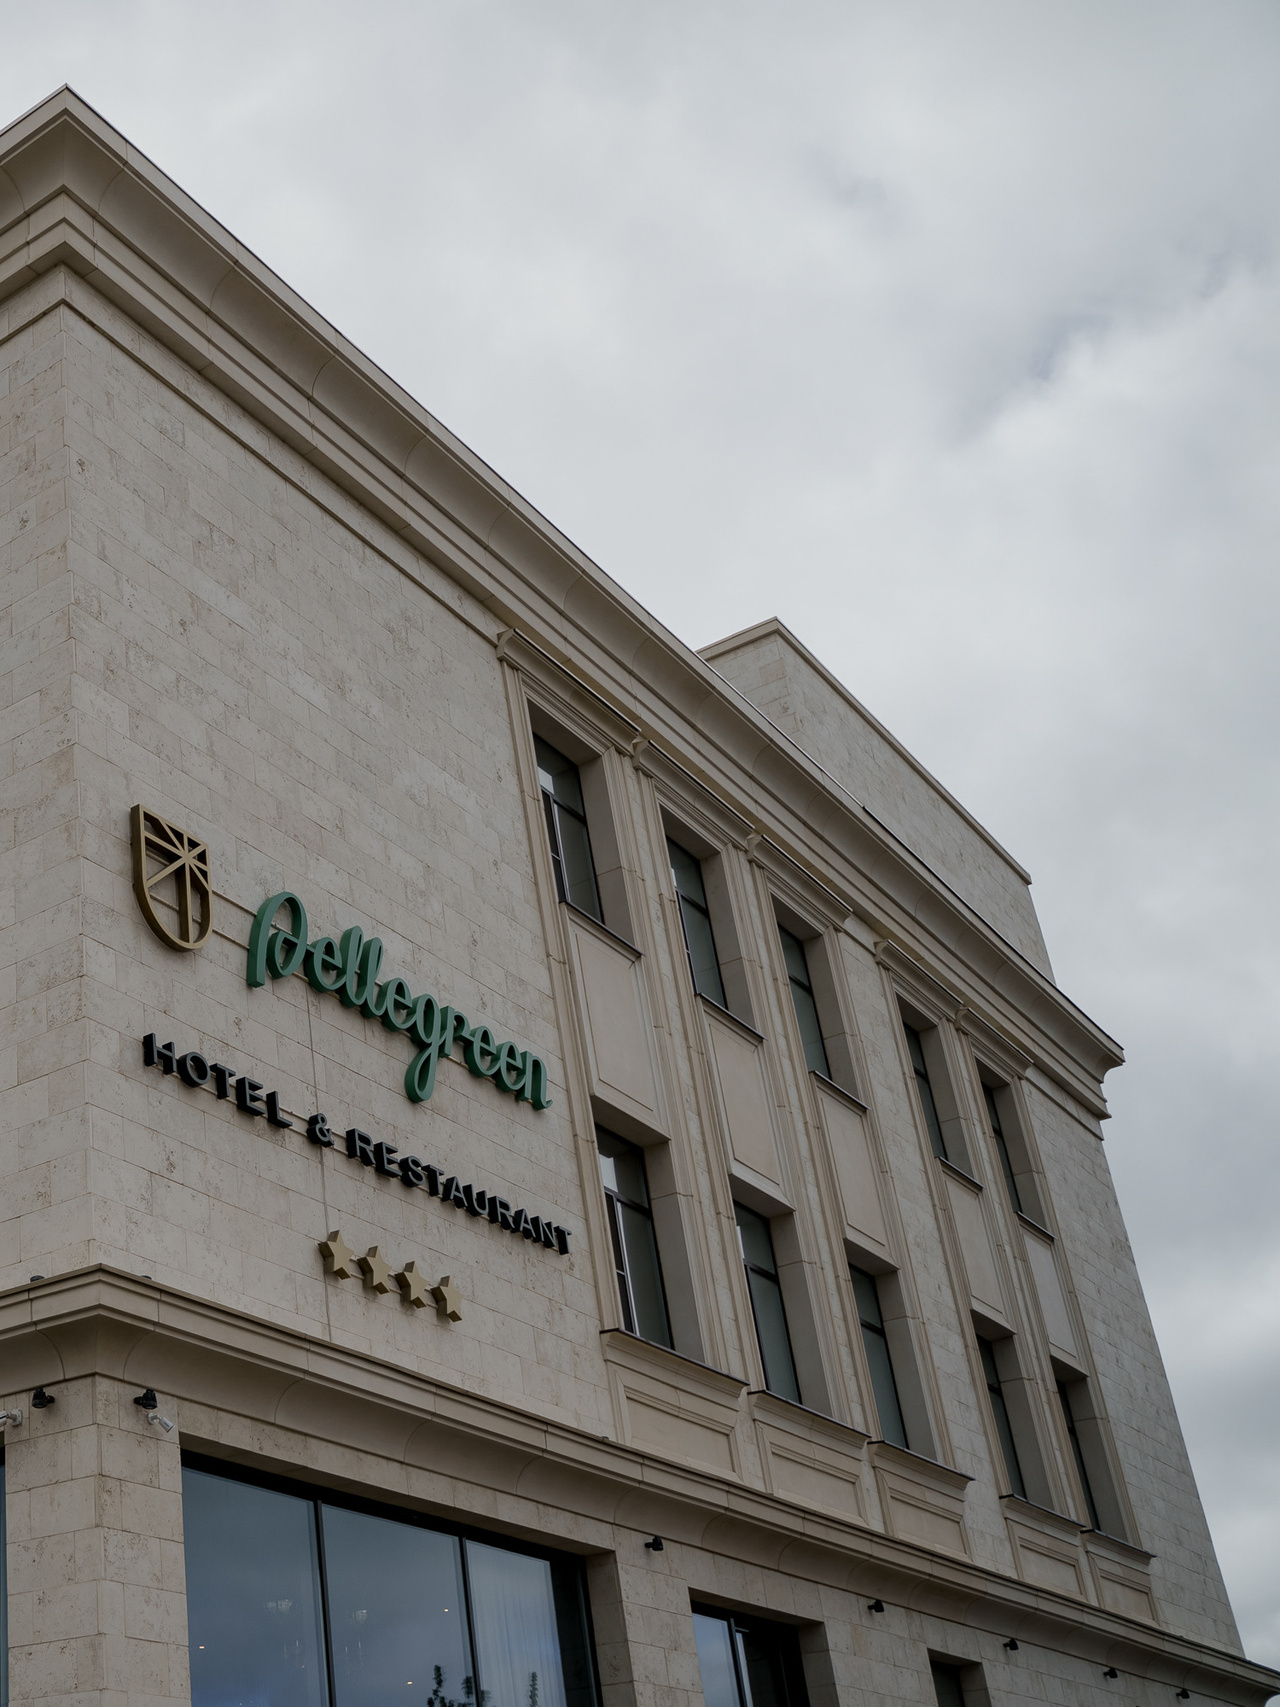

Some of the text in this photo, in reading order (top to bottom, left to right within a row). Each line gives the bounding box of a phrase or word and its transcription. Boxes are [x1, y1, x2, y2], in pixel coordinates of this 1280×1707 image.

[247, 891, 553, 1109] Pellegreen
[143, 1032, 572, 1255] HOTEL & RESTAURANT
